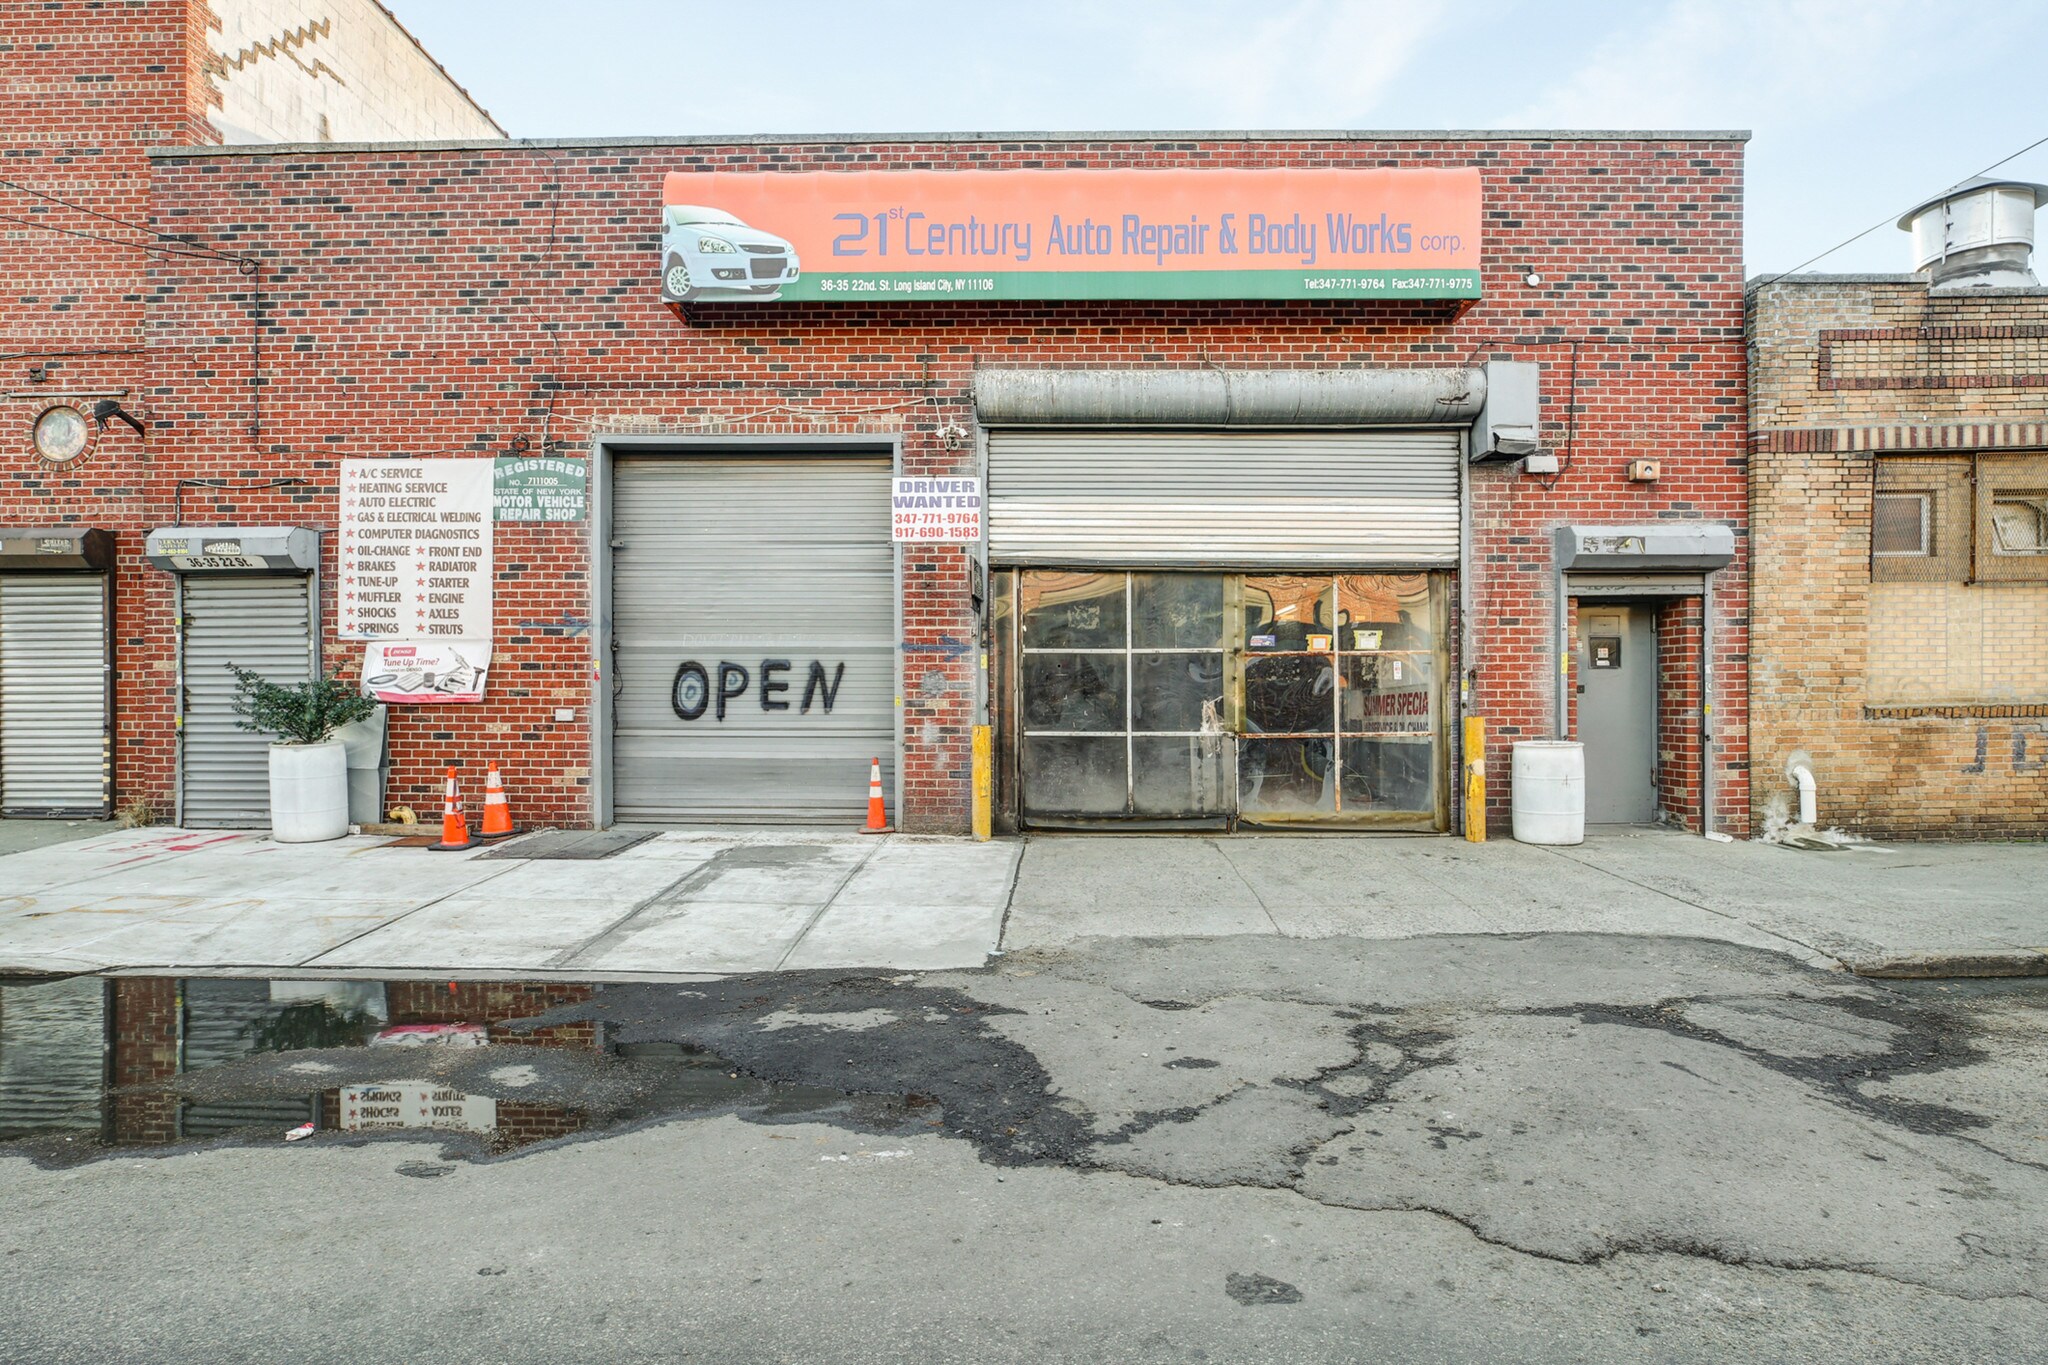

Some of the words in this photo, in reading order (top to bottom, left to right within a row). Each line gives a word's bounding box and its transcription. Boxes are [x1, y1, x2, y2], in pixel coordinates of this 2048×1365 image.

[906, 212, 1030, 261] Century
[1047, 215, 1112, 255] Auto
[1123, 214, 1209, 265] Repair
[1220, 213, 1237, 253] &
[1248, 213, 1316, 264] Body
[1326, 213, 1411, 253] Works
[1420, 237, 1465, 255] corp.
[821, 280, 849, 291] 36-35
[852, 280, 876, 291] 22nd.
[880, 280, 891, 291] St.
[894, 280, 912, 293] Long
[914, 280, 936, 291] Island
[938, 280, 953, 293] City,
[955, 280, 965, 290] NY
[968, 280, 993, 291] 11106
[359, 469, 379, 478] A/C
[381, 469, 422, 478] SERVICE
[494, 460, 585, 479] REGISTERED
[527, 477, 559, 485] 7111005
[359, 483, 401, 493] HEATING
[405, 483, 447, 493] SERVICE
[900, 481, 975, 493] DRIVER
[359, 497, 385, 507] AUTO
[389, 497, 435, 507] ELECTRIC
[493, 496, 532, 507] MOTOR
[537, 496, 583, 507] VEHICLE
[893, 496, 980, 508] WANTED
[358, 512, 375, 523] GAS
[377, 513, 384, 523] &
[387, 512, 437, 523] ELECTRICAL
[441, 512, 481, 523] WELDING
[500, 508, 540, 520] REPAIR
[546, 509, 576, 520] SHOP
[895, 513, 978, 524] 347-771-9764
[358, 529, 411, 539] COMPUTER
[415, 529, 479, 539] DIAGNOSTICS
[895, 527, 978, 537] 917-690-1583
[358, 545, 410, 556] OIL-CHANGE
[429, 547, 459, 557] FRONT
[463, 547, 482, 557] END
[187, 558, 219, 567] 36-35
[220, 558, 235, 567] 22
[235, 558, 253, 567] St.
[358, 561, 396, 571] BRAKES
[429, 562, 476, 572] RADIATOR
[358, 577, 397, 587] TUNE-UP
[429, 578, 469, 588] STARTER
[358, 592, 401, 602] MUFFLER
[429, 593, 464, 604] ENGINE
[358, 607, 396, 618] SHOCKS
[429, 609, 459, 619] AXLES
[358, 623, 399, 634] SPRINGS
[429, 624, 463, 635] STRUTS
[383, 658, 401, 667] Tune
[403, 658, 414, 667] Up
[416, 658, 440, 666] Time?
[672, 659, 844, 722] OPEN
